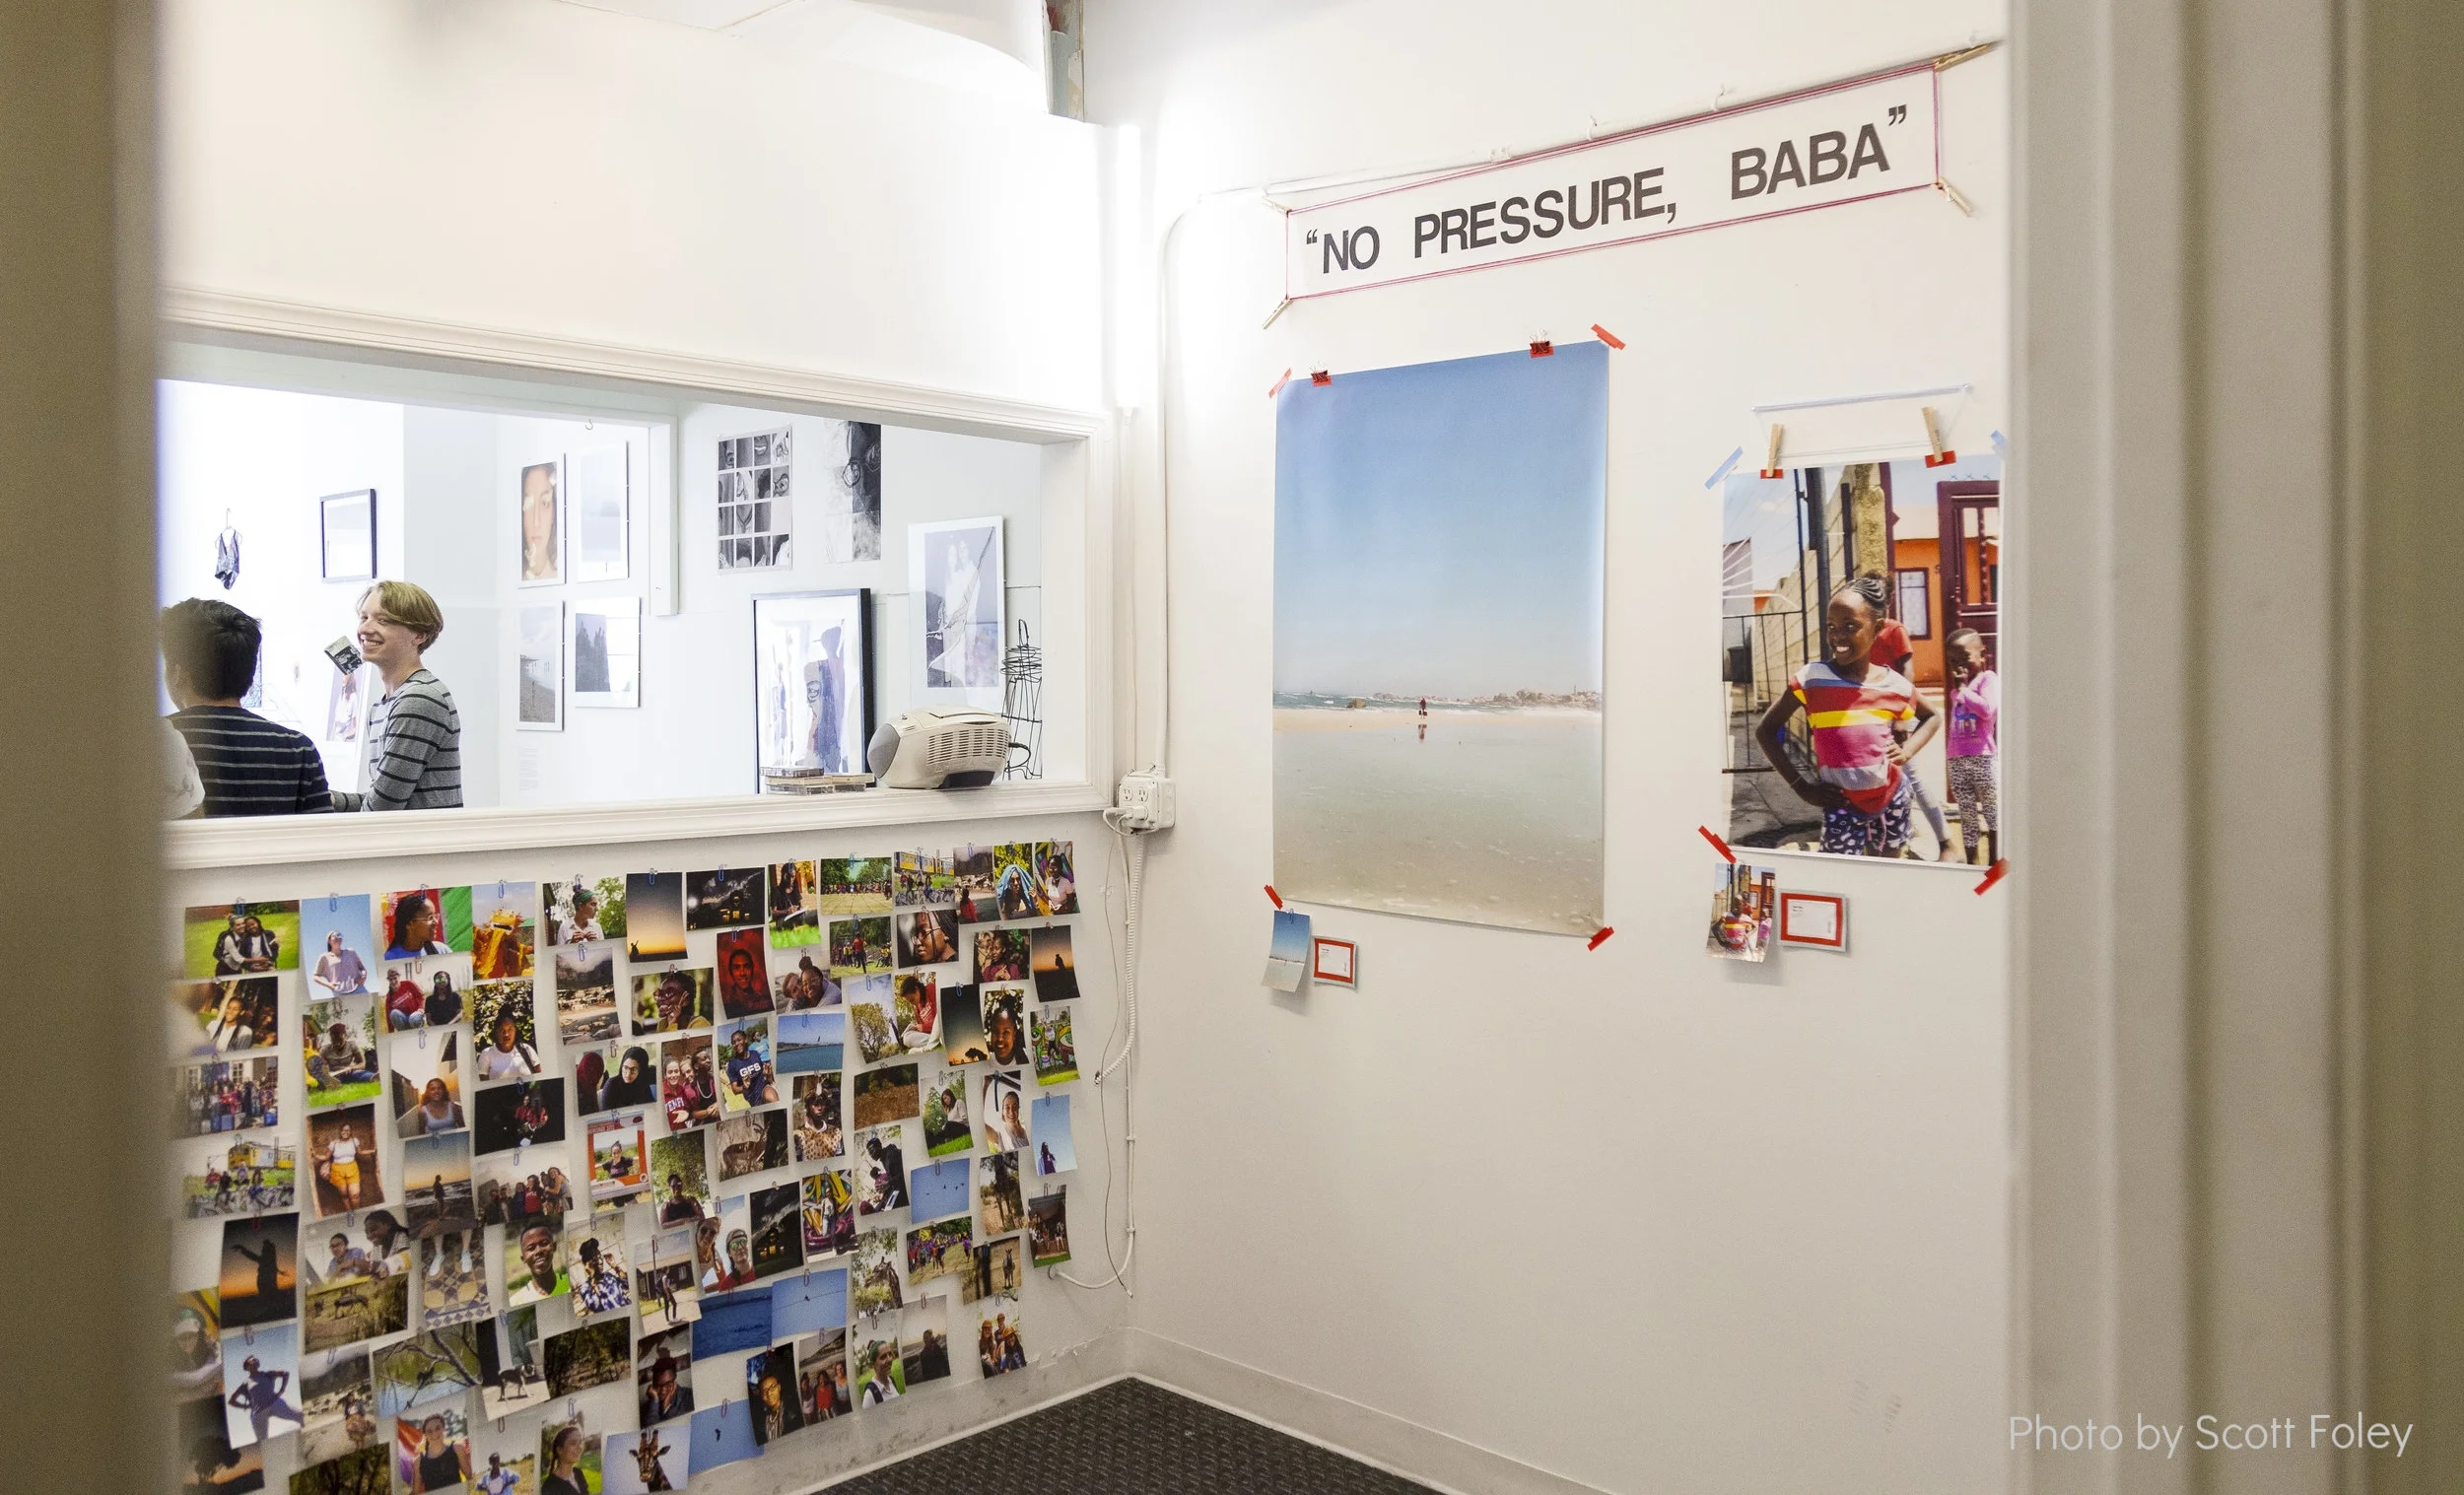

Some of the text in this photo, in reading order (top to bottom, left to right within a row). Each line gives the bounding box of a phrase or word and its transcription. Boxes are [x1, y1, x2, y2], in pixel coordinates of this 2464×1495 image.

[1306, 102, 1908, 274] “NO PRESSURE, BABA”
[739, 1062, 761, 1078] GFS
